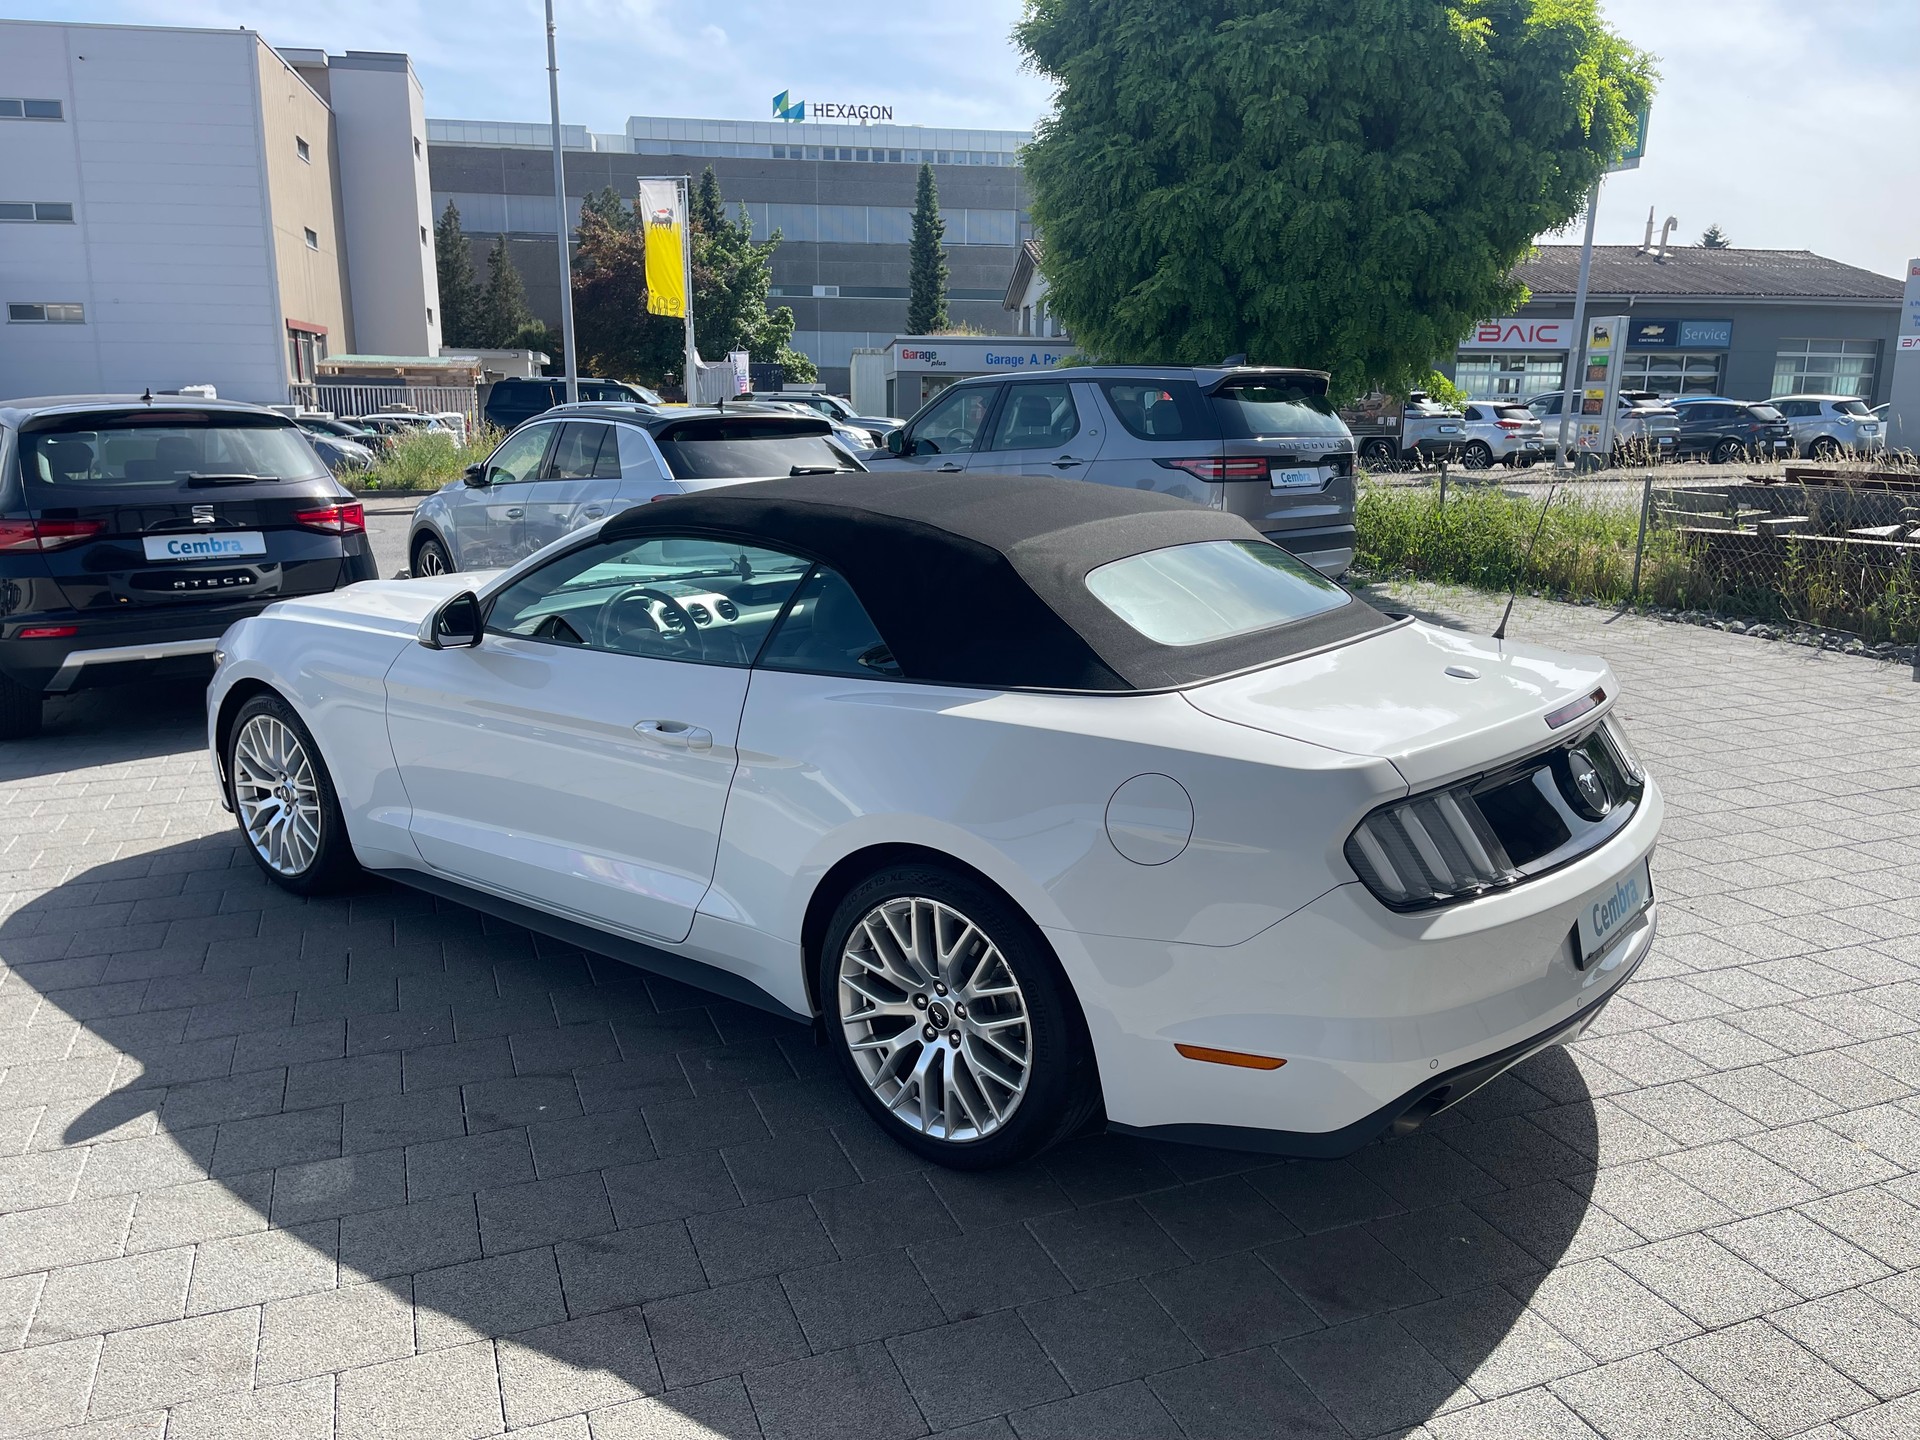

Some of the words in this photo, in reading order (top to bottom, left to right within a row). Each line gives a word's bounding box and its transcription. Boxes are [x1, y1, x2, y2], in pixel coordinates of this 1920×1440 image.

[814, 103, 892, 120] HEXAGON
[1478, 325, 1559, 342] BAIC
[1684, 328, 1727, 340] Service
[902, 349, 937, 362] Garage
[986, 352, 1024, 367] Garage
[1030, 353, 1040, 365] A.
[1281, 470, 1311, 483] Cembra
[167, 537, 243, 554] Cembra
[174, 577, 250, 588] ATECA
[1592, 879, 1639, 937] Cembra
